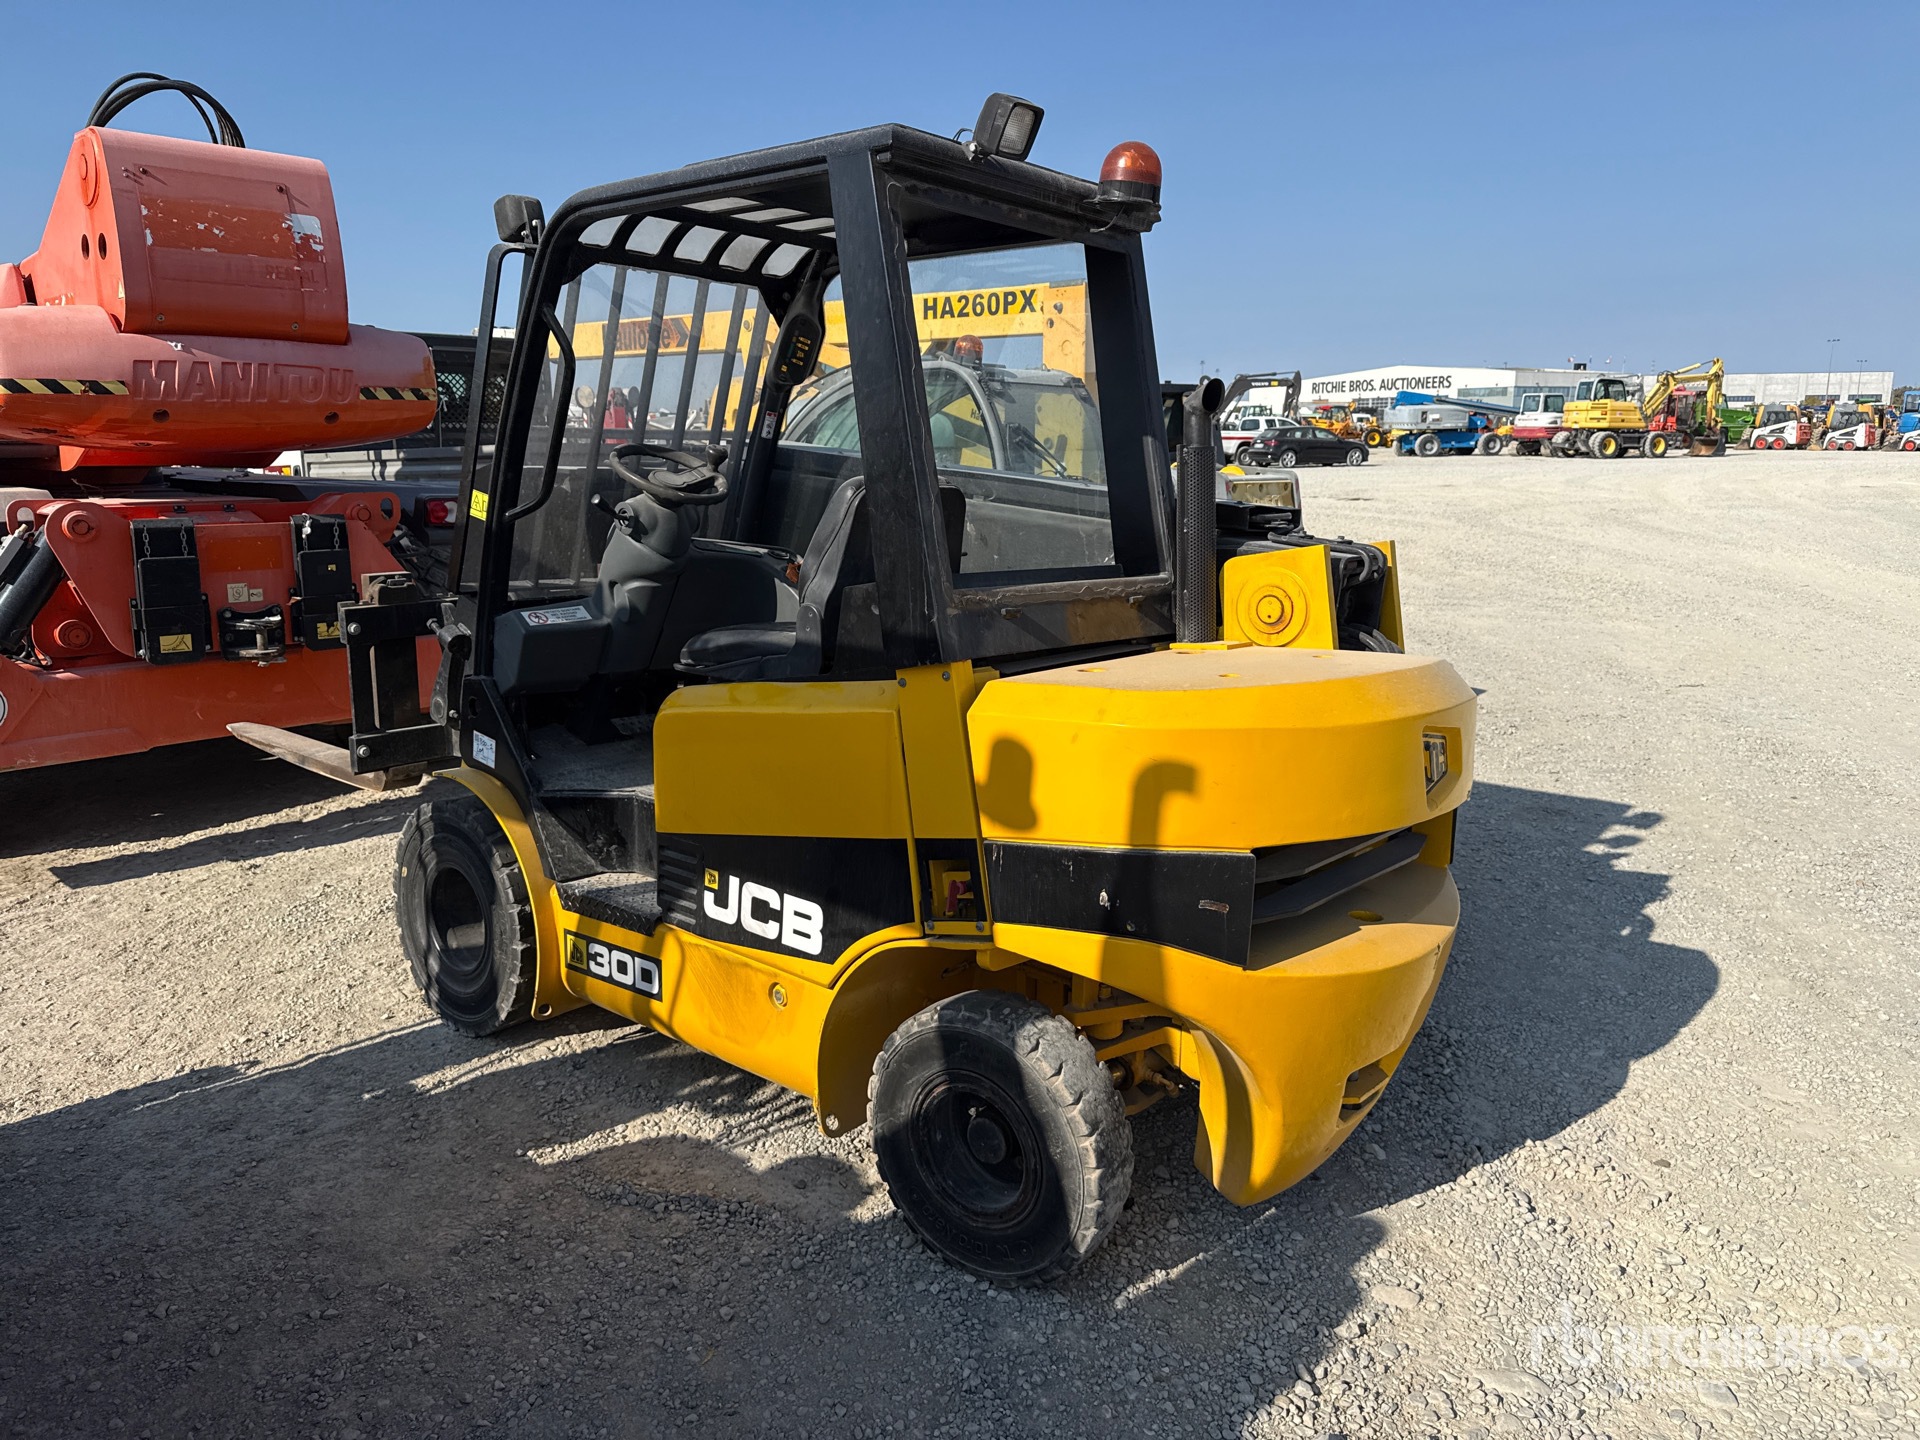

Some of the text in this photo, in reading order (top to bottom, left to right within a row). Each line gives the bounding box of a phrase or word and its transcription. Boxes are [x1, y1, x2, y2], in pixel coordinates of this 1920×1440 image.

[265, 264, 319, 284] RENAL
[923, 289, 1037, 320] HA260PX
[132, 359, 355, 404] MANITOU
[1311, 375, 1452, 394] RITCHIE BROS. AUCTIONEERS
[703, 874, 824, 956] JCB
[588, 942, 660, 994] 30D
